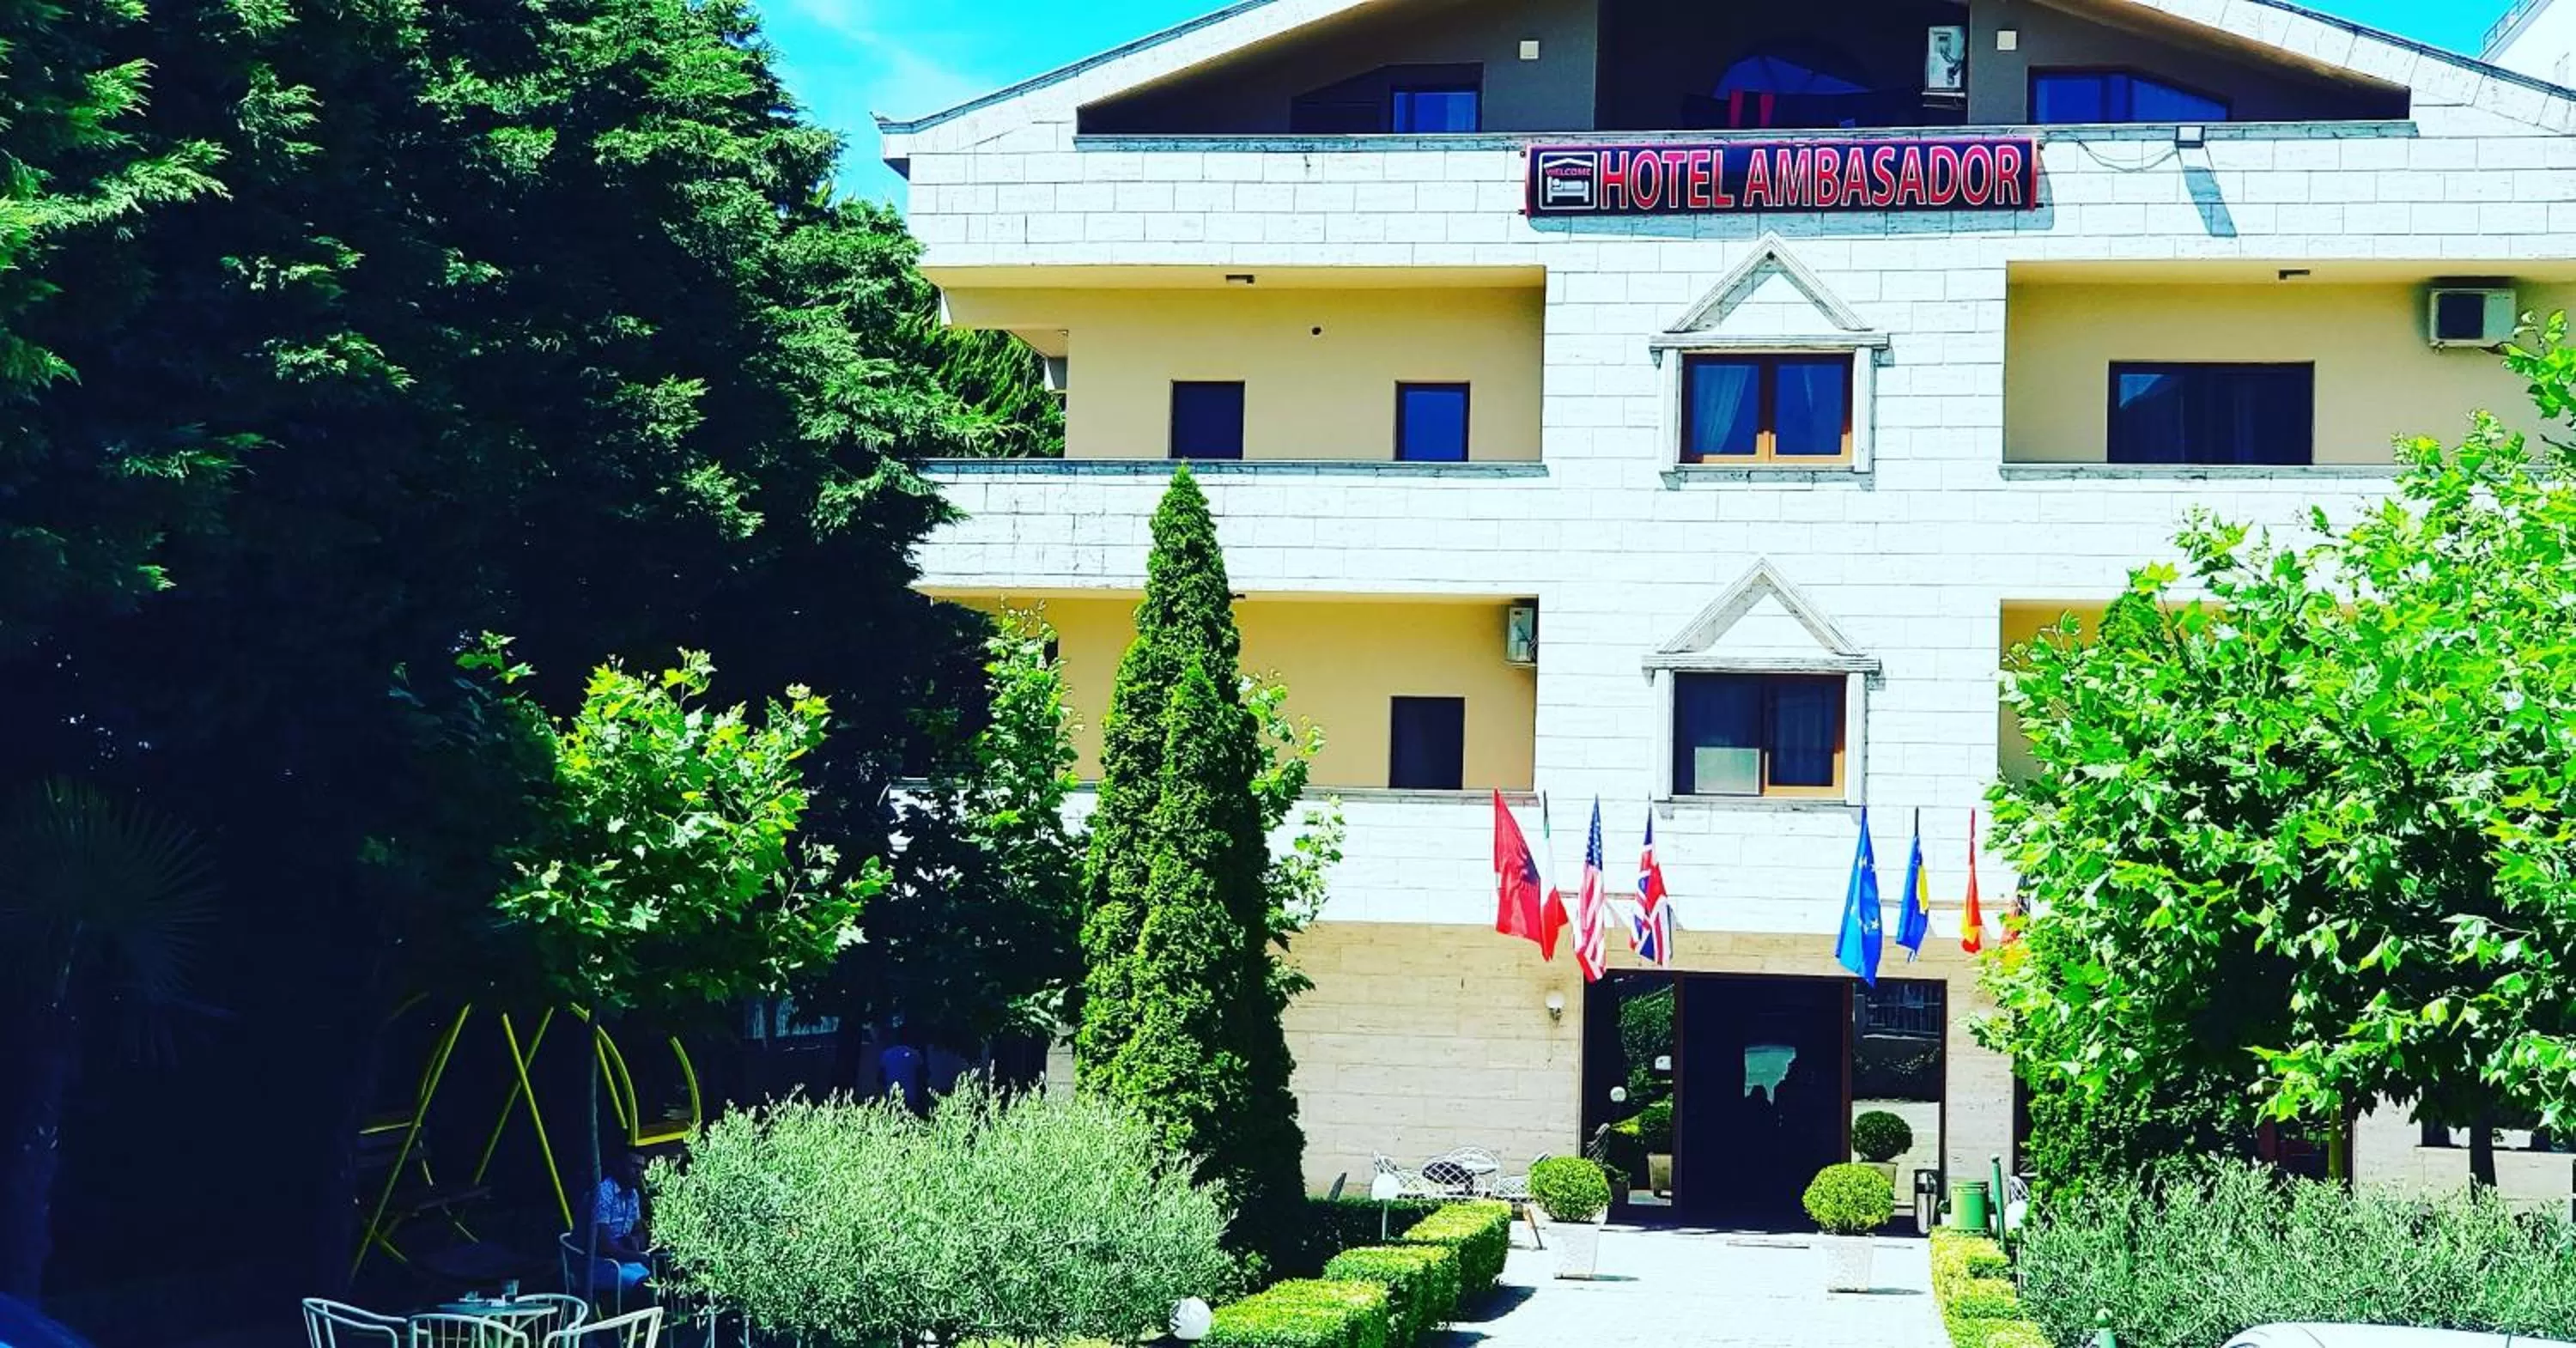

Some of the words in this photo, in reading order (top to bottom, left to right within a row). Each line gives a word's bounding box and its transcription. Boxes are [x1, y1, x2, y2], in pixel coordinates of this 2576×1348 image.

[1546, 167, 1592, 176] WELCOME
[1600, 149, 1735, 209] HOTEL
[1743, 144, 2022, 207] AMBASADOR
